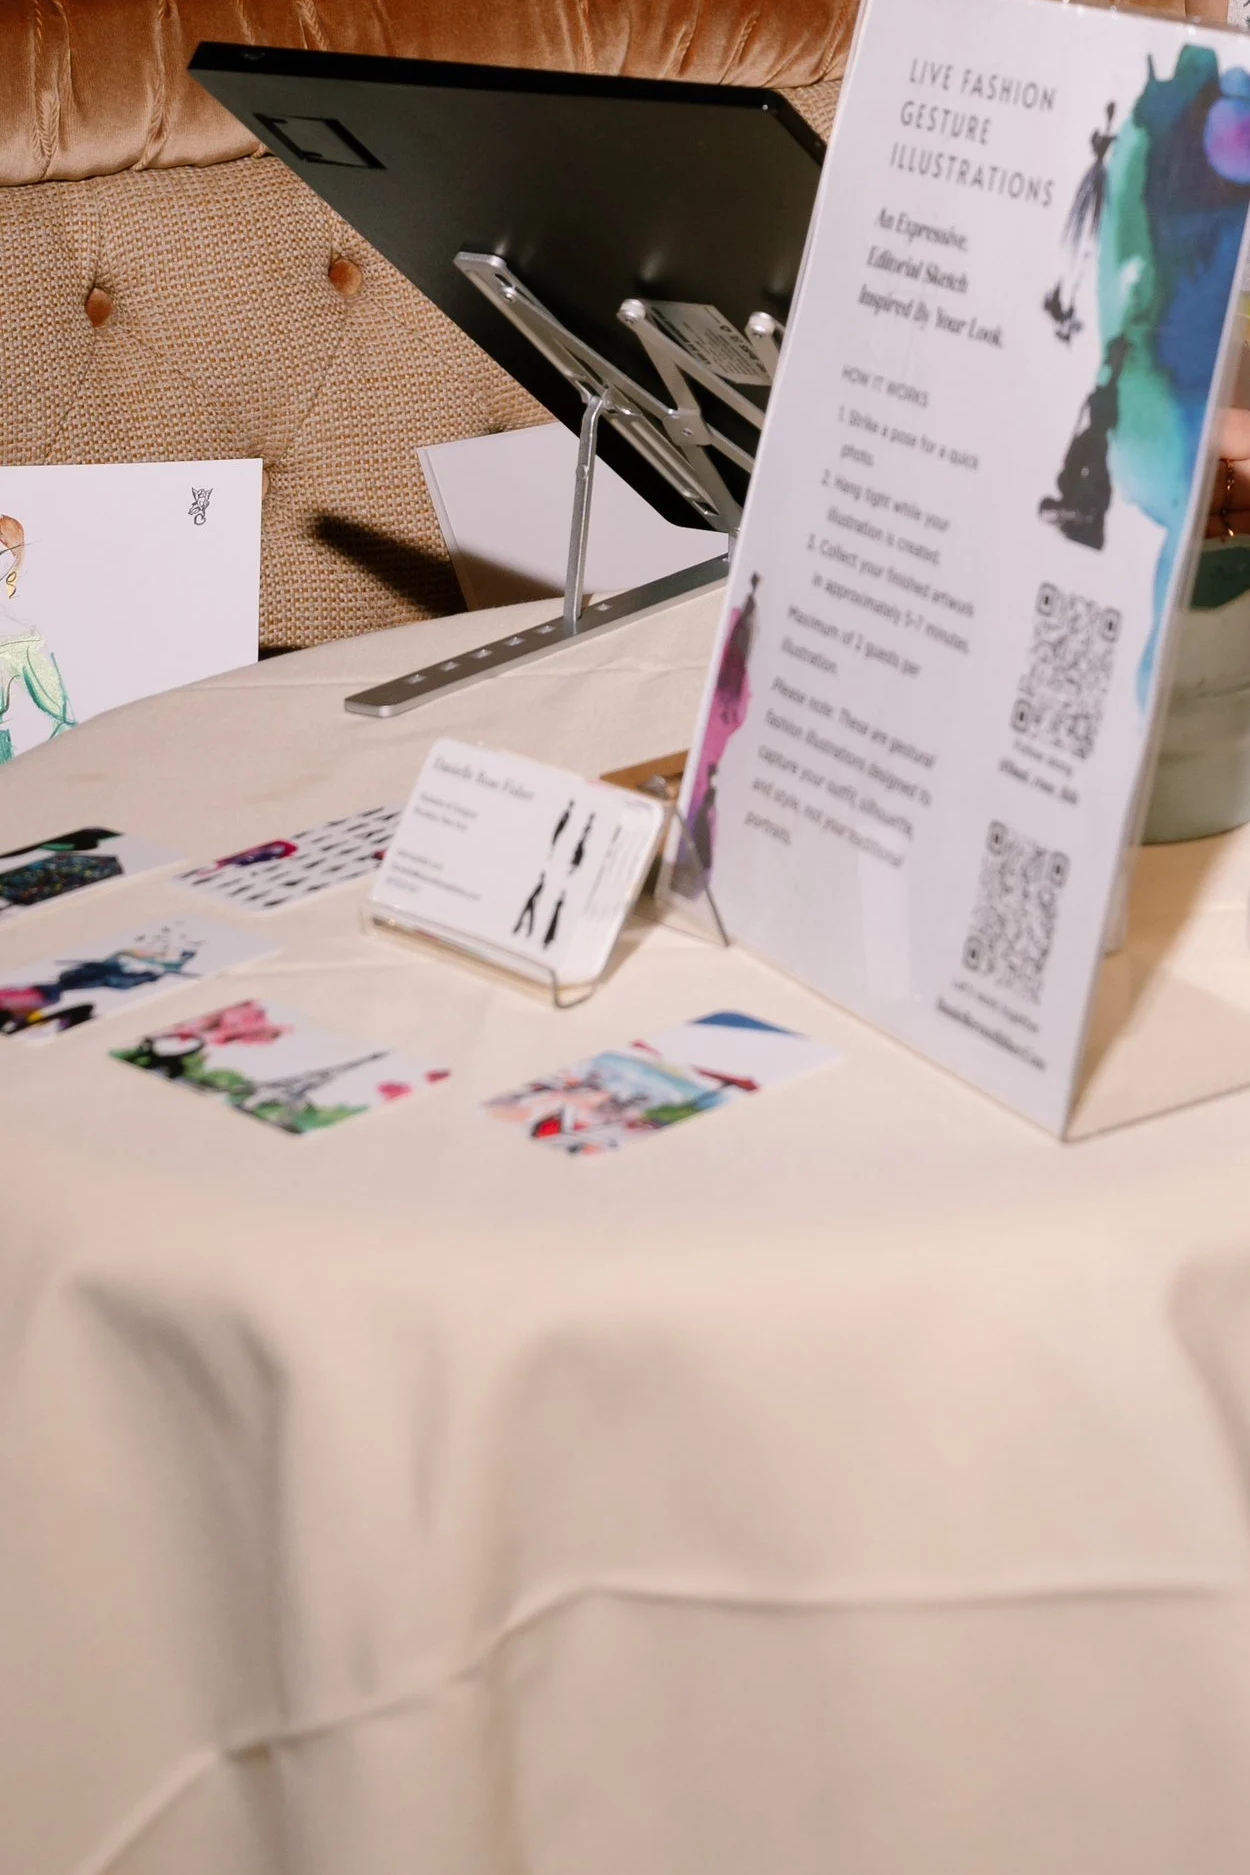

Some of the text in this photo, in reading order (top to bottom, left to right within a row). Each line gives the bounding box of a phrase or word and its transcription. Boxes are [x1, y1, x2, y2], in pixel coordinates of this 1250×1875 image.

[909, 59, 1056, 110] LIVE FASHION
[900, 100, 990, 145] GESTURE
[889, 142, 1054, 208] ILLUSTRATIONS
[877, 208, 895, 230] An
[866, 246, 968, 293] Editorial Sketch
[858, 284, 914, 318] Inspired
[912, 300, 930, 329] By
[936, 306, 968, 334] Your
[842, 366, 928, 408] HOW IT WORKS
[848, 410, 879, 434] Strike
[889, 428, 918, 448] pose
[918, 435, 937, 454] for
[946, 449, 978, 470] quick
[892, 501, 922, 520] while
[924, 513, 950, 532] your
[819, 540, 858, 568] Collect
[858, 560, 884, 579] your
[886, 566, 932, 600] finished
[930, 589, 974, 618] artwork
[788, 604, 839, 640] Maximum
[840, 630, 855, 646] of
[899, 659, 921, 677] per
[770, 676, 806, 705] Please
[838, 708, 870, 737] These
[869, 728, 888, 746] are
[752, 778, 774, 798] and
[758, 745, 799, 774] capture
[799, 768, 827, 789] your
